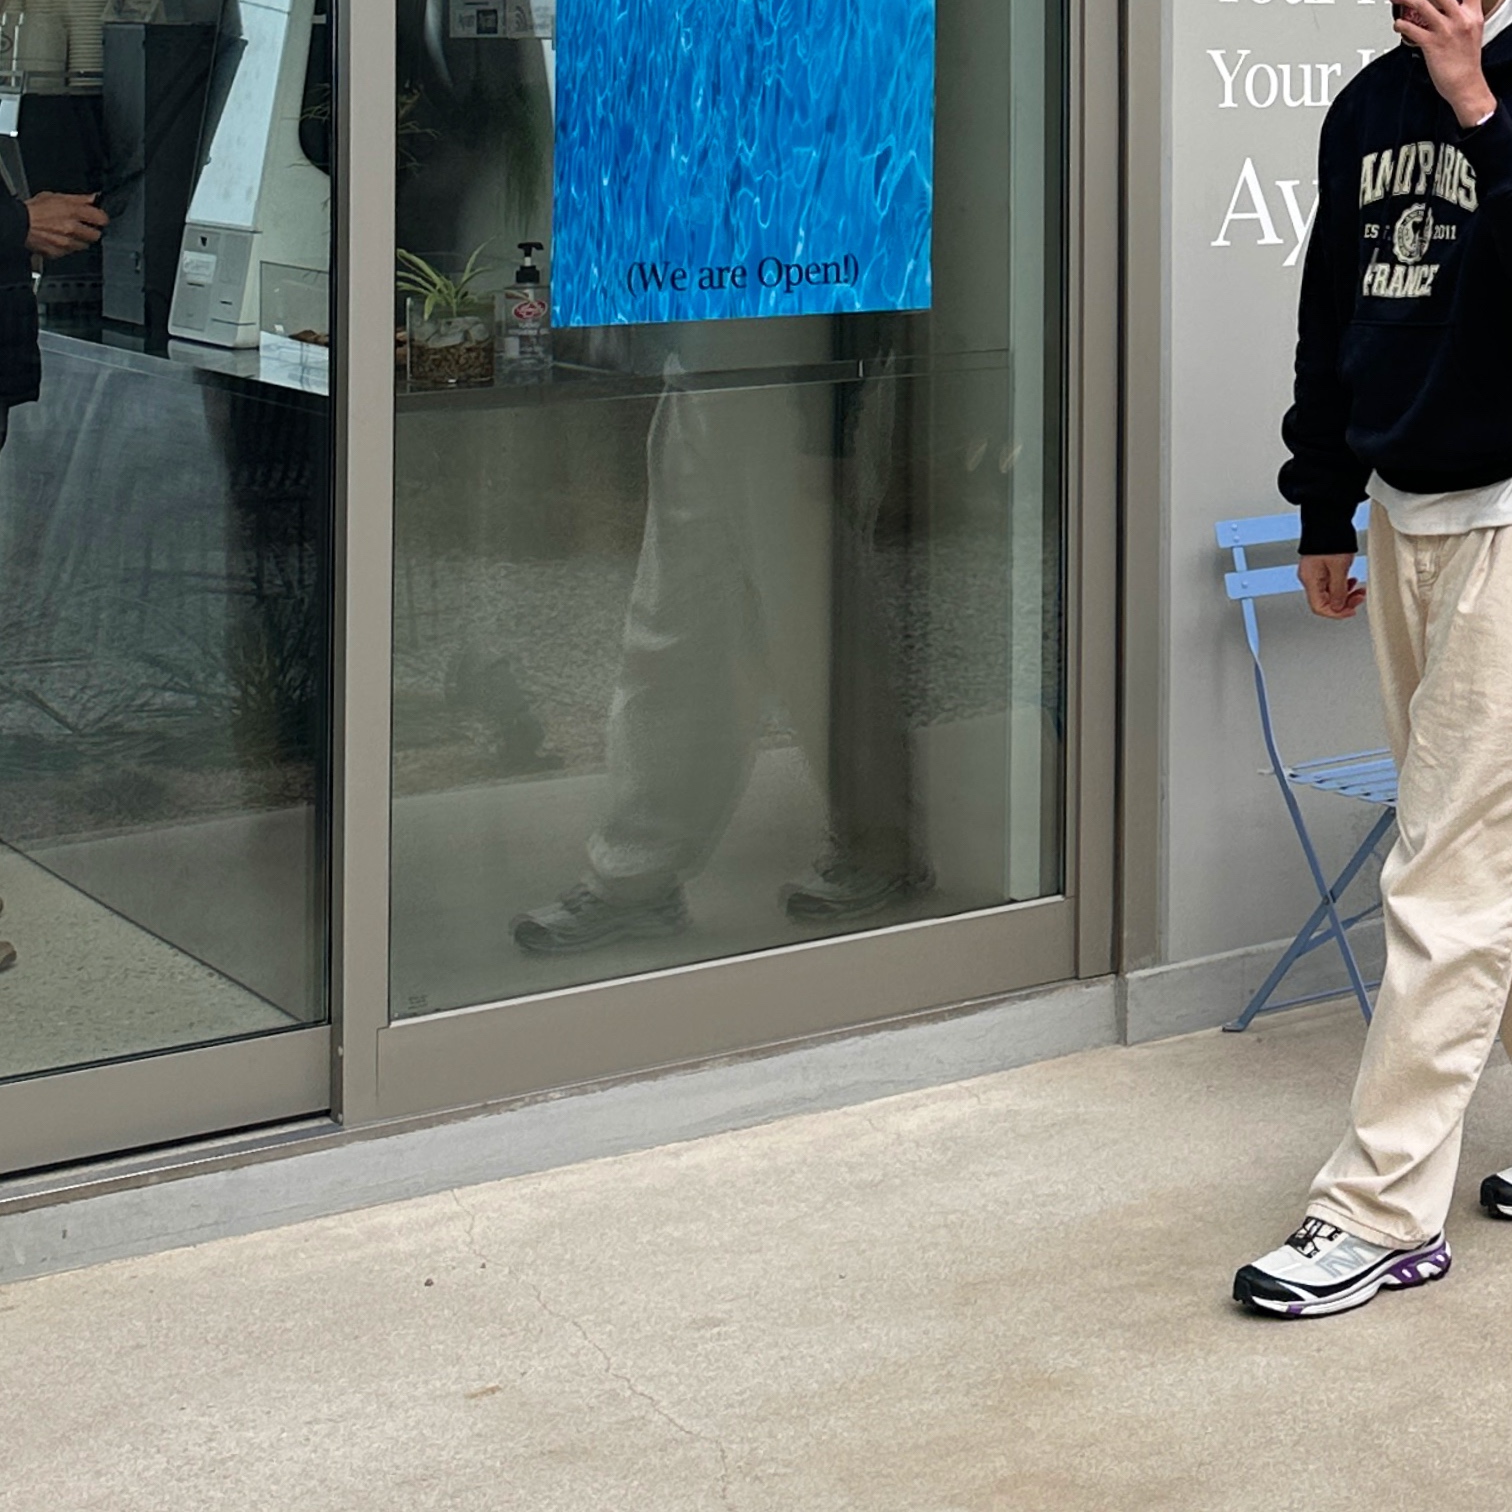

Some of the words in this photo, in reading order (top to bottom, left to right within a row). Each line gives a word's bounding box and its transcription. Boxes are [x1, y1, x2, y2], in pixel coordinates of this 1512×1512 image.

[1206, 49, 1343, 108] Your
[1433, 225, 1457, 240] 2011
[626, 261, 687, 297] (We
[698, 262, 747, 289] are
[757, 253, 859, 294] Open!)
[1363, 262, 1441, 298] FRANCE
